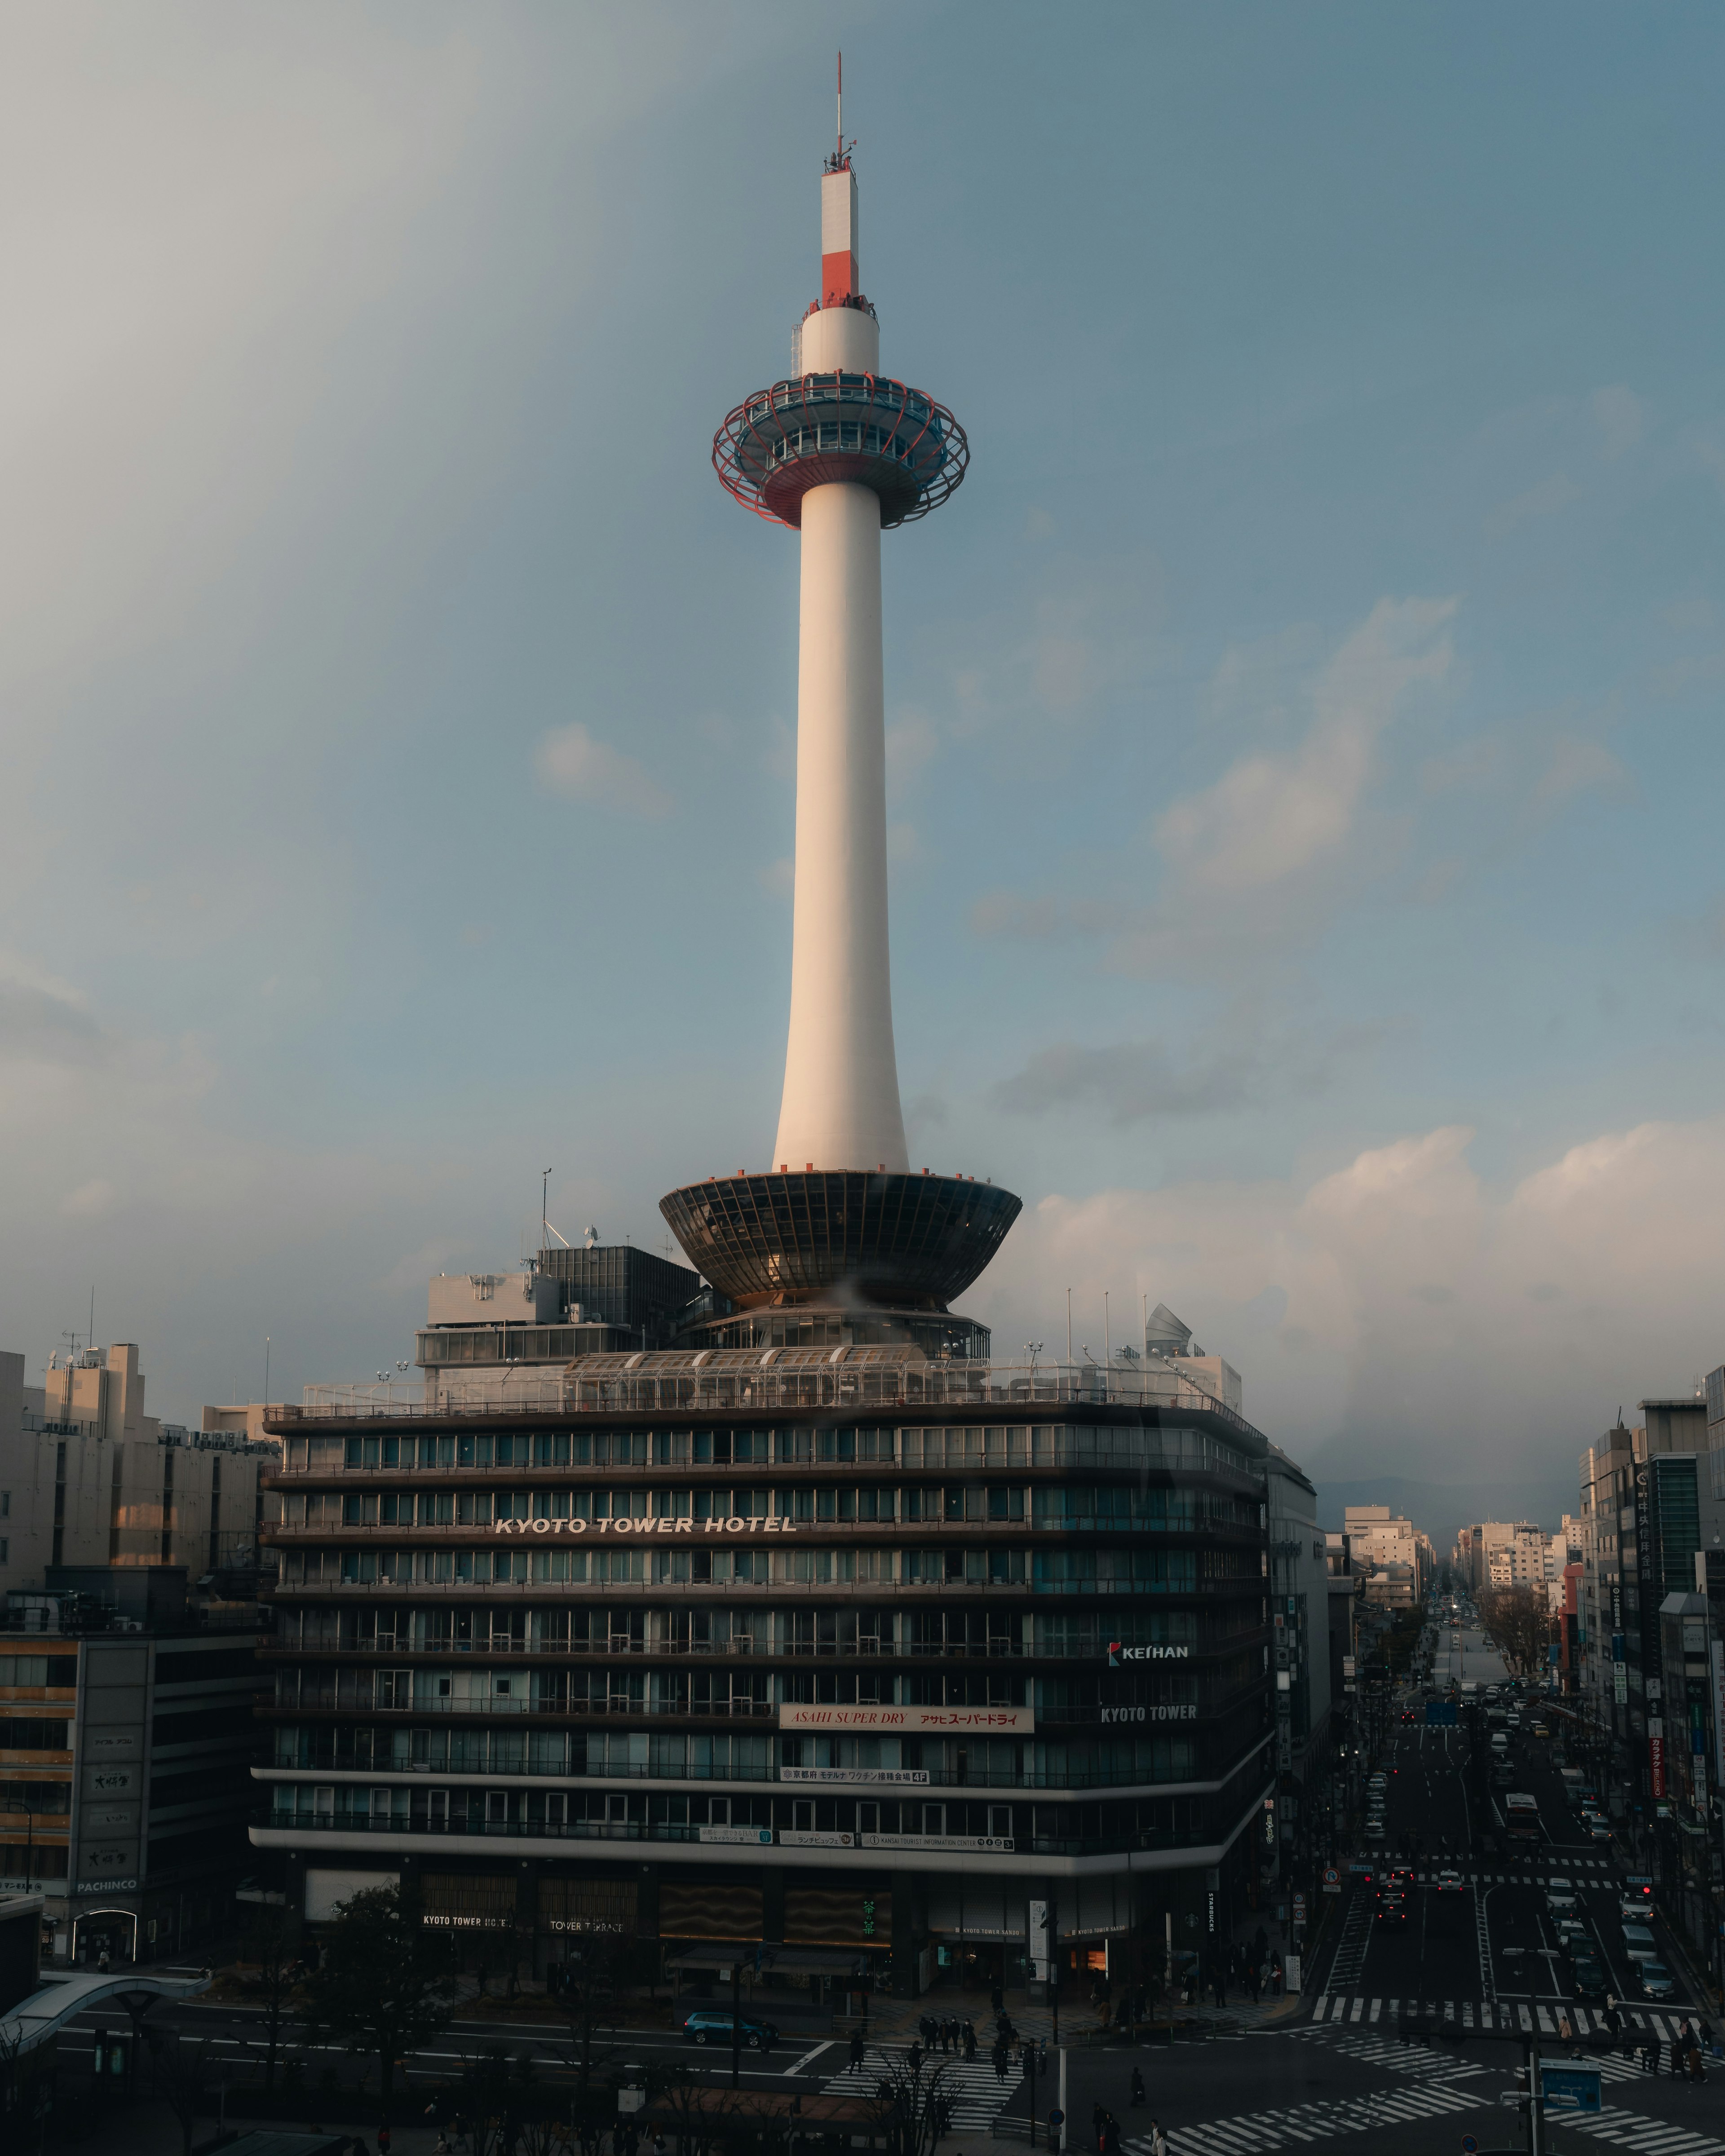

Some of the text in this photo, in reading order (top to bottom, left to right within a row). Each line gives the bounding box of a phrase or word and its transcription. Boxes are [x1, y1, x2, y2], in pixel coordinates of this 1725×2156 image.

[495, 1517, 797, 1533] KYOTO TOWER HOTEL
[1638, 1503, 1652, 1580] 中央信用金庫
[1123, 1646, 1188, 1659] KEIHAN
[792, 1712, 908, 1723] ASAHI SUPER DRY
[921, 1714, 1017, 1725] アサヒスーパードライ
[1101, 1705, 1196, 1723] KYOTO TOWER
[1652, 1739, 1661, 1767] カラオケ
[95, 1776, 129, 1789] 大将軍
[793, 1771, 817, 1779] 京都府
[849, 1772, 911, 1781] ワクチン接種会場
[914, 1773, 925, 1781] 4F
[89, 1851, 128, 1867] 大将軍
[78, 1880, 137, 1892] PACHINCO
[424, 1916, 450, 1925] KYOTO
[453, 1917, 481, 1926] TOWER
[551, 1921, 581, 1931] TOWER
